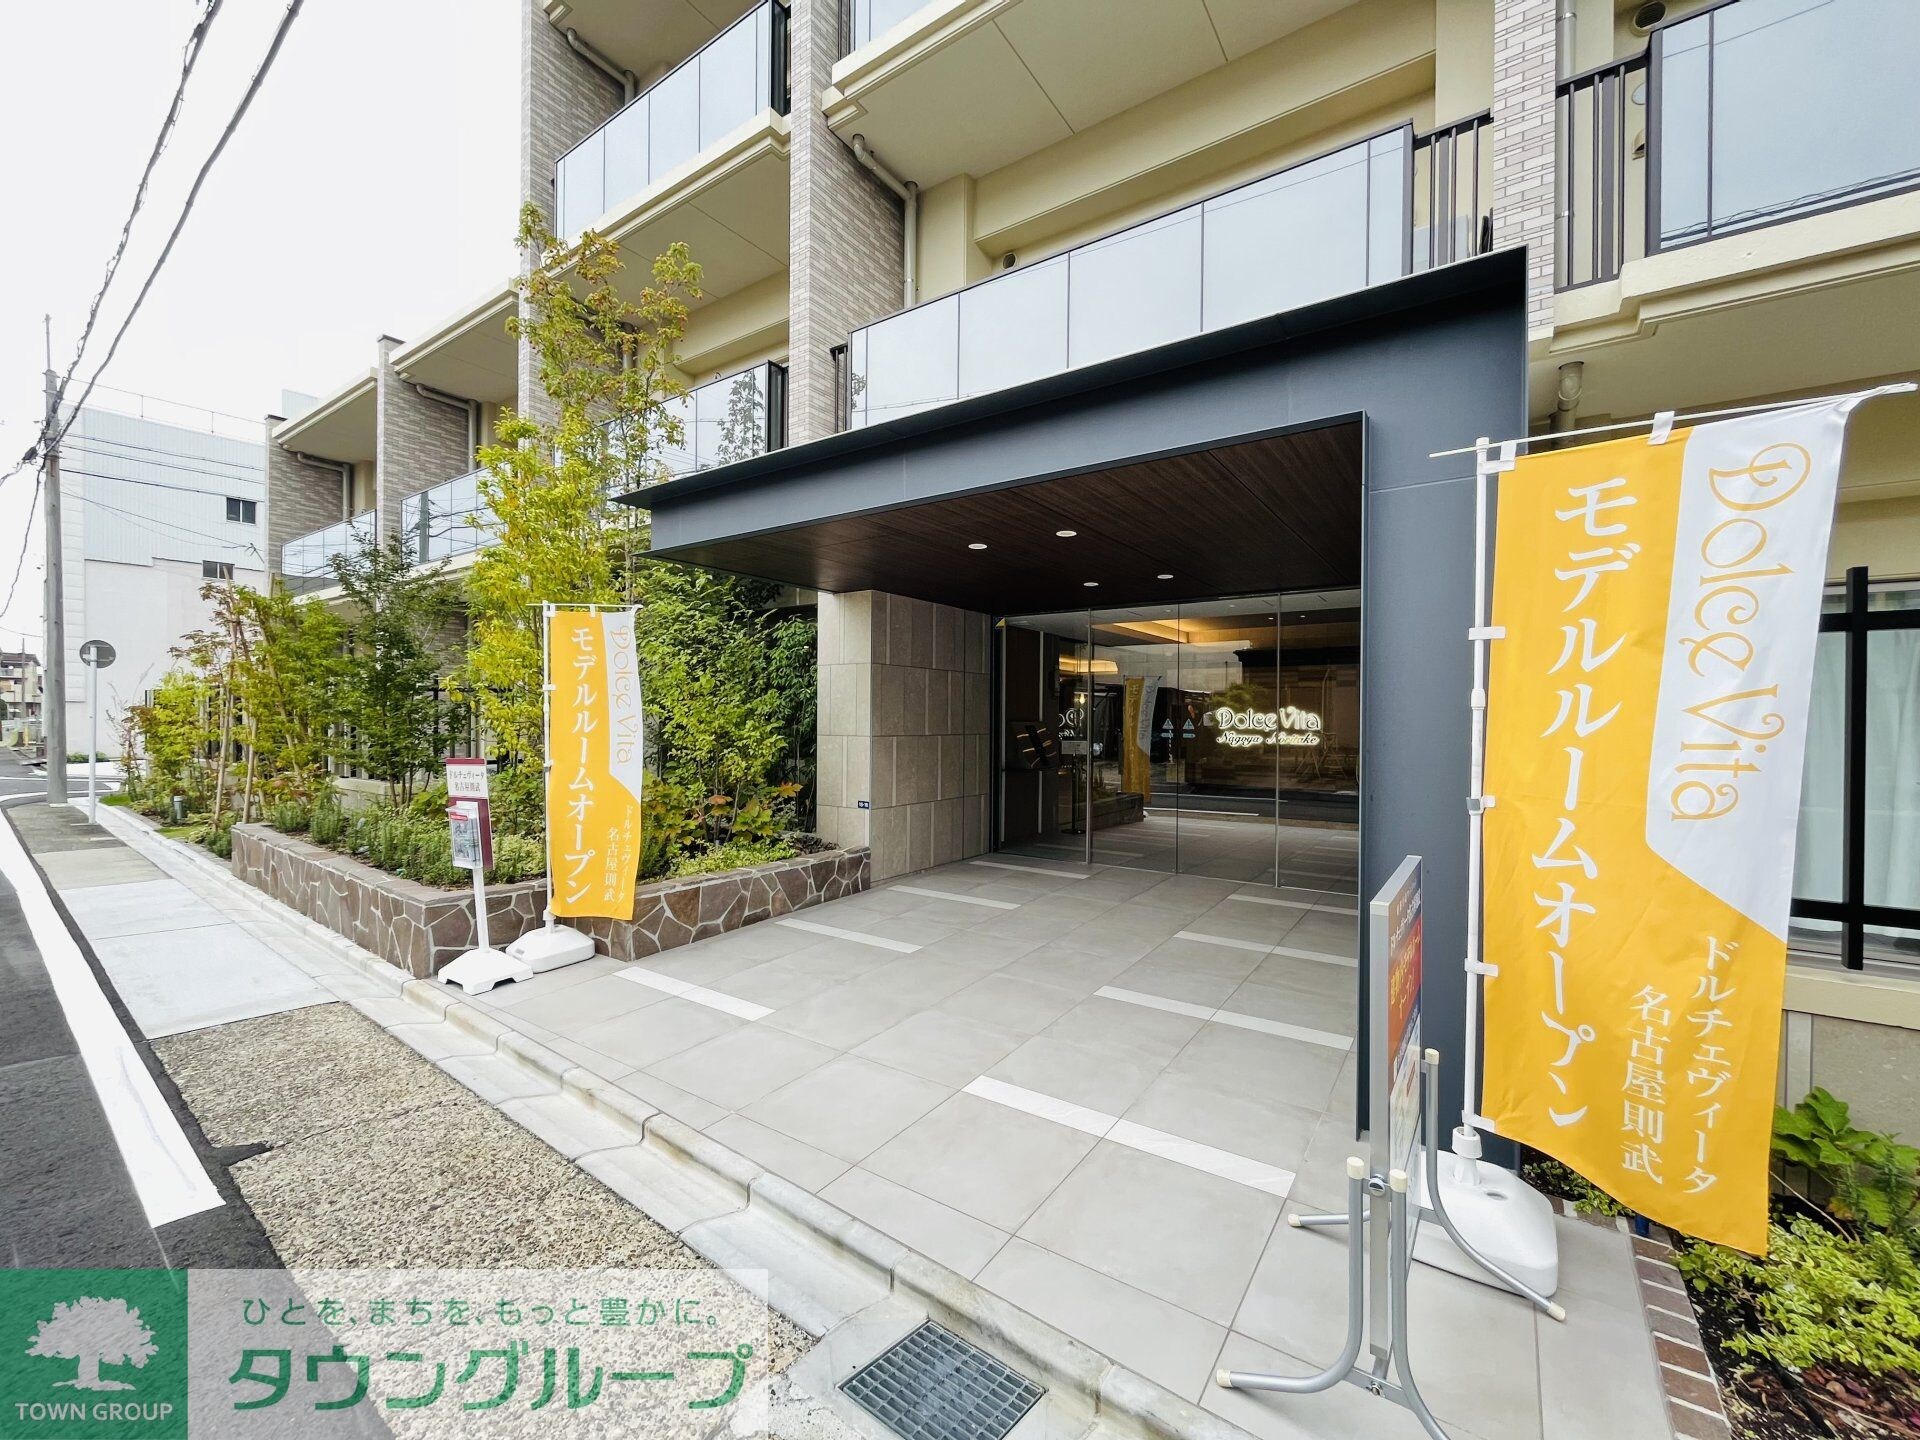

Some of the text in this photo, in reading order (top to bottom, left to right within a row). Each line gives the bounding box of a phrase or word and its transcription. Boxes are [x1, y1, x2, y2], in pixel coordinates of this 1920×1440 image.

[610, 625, 640, 764] Dolce Vita
[1670, 442, 1811, 822] Dolce Vita
[564, 627, 598, 904] モデルルームオープン
[1215, 706, 1321, 732] Dolce Vita
[1216, 731, 1264, 747] Nagoya
[1532, 478, 1641, 1127] モデルルームオープン
[603, 826, 620, 903] 名古屋則武
[616, 804, 633, 904] ドルチェヴィータ
[1620, 984, 1672, 1185] 名古屋則武
[1683, 936, 1740, 1194] ドルチェヴィータ
